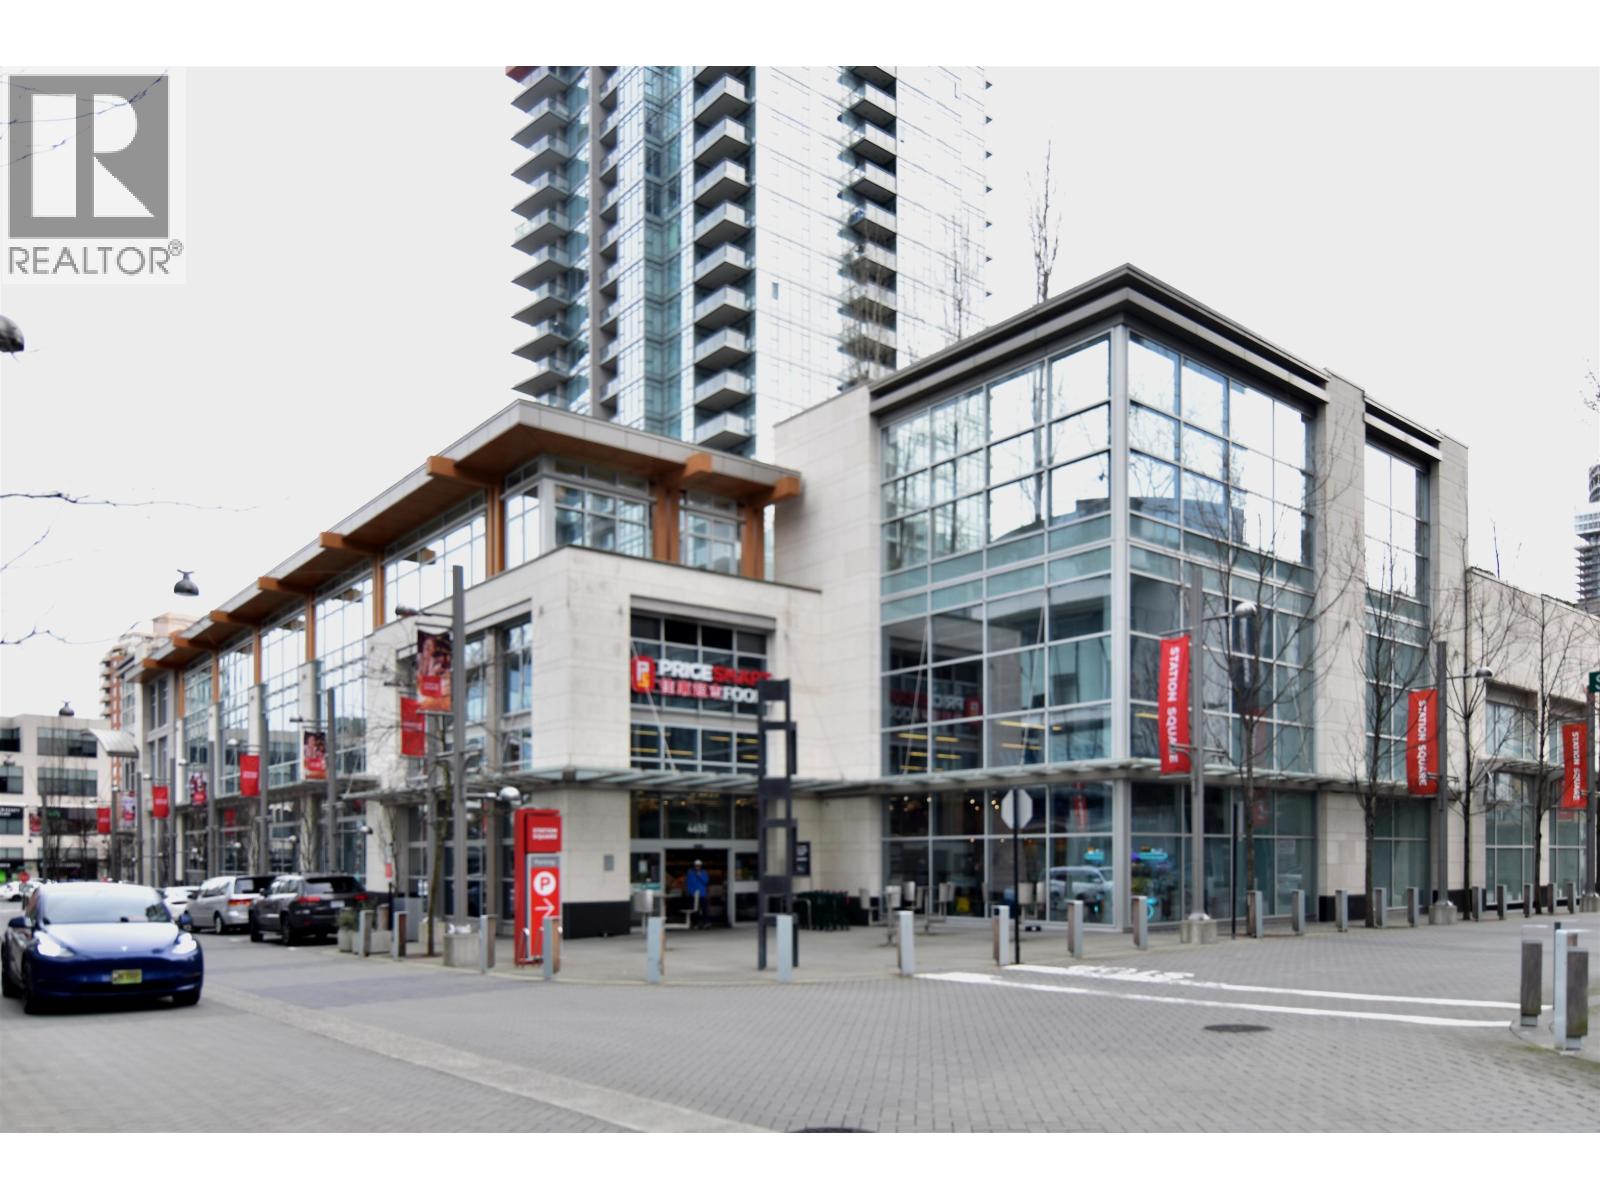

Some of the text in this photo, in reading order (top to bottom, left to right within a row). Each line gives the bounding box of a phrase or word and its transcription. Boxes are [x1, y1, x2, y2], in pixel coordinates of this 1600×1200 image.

[1167, 646, 1180, 702] STATION
[1417, 700, 1427, 786] STATION SQUARE
